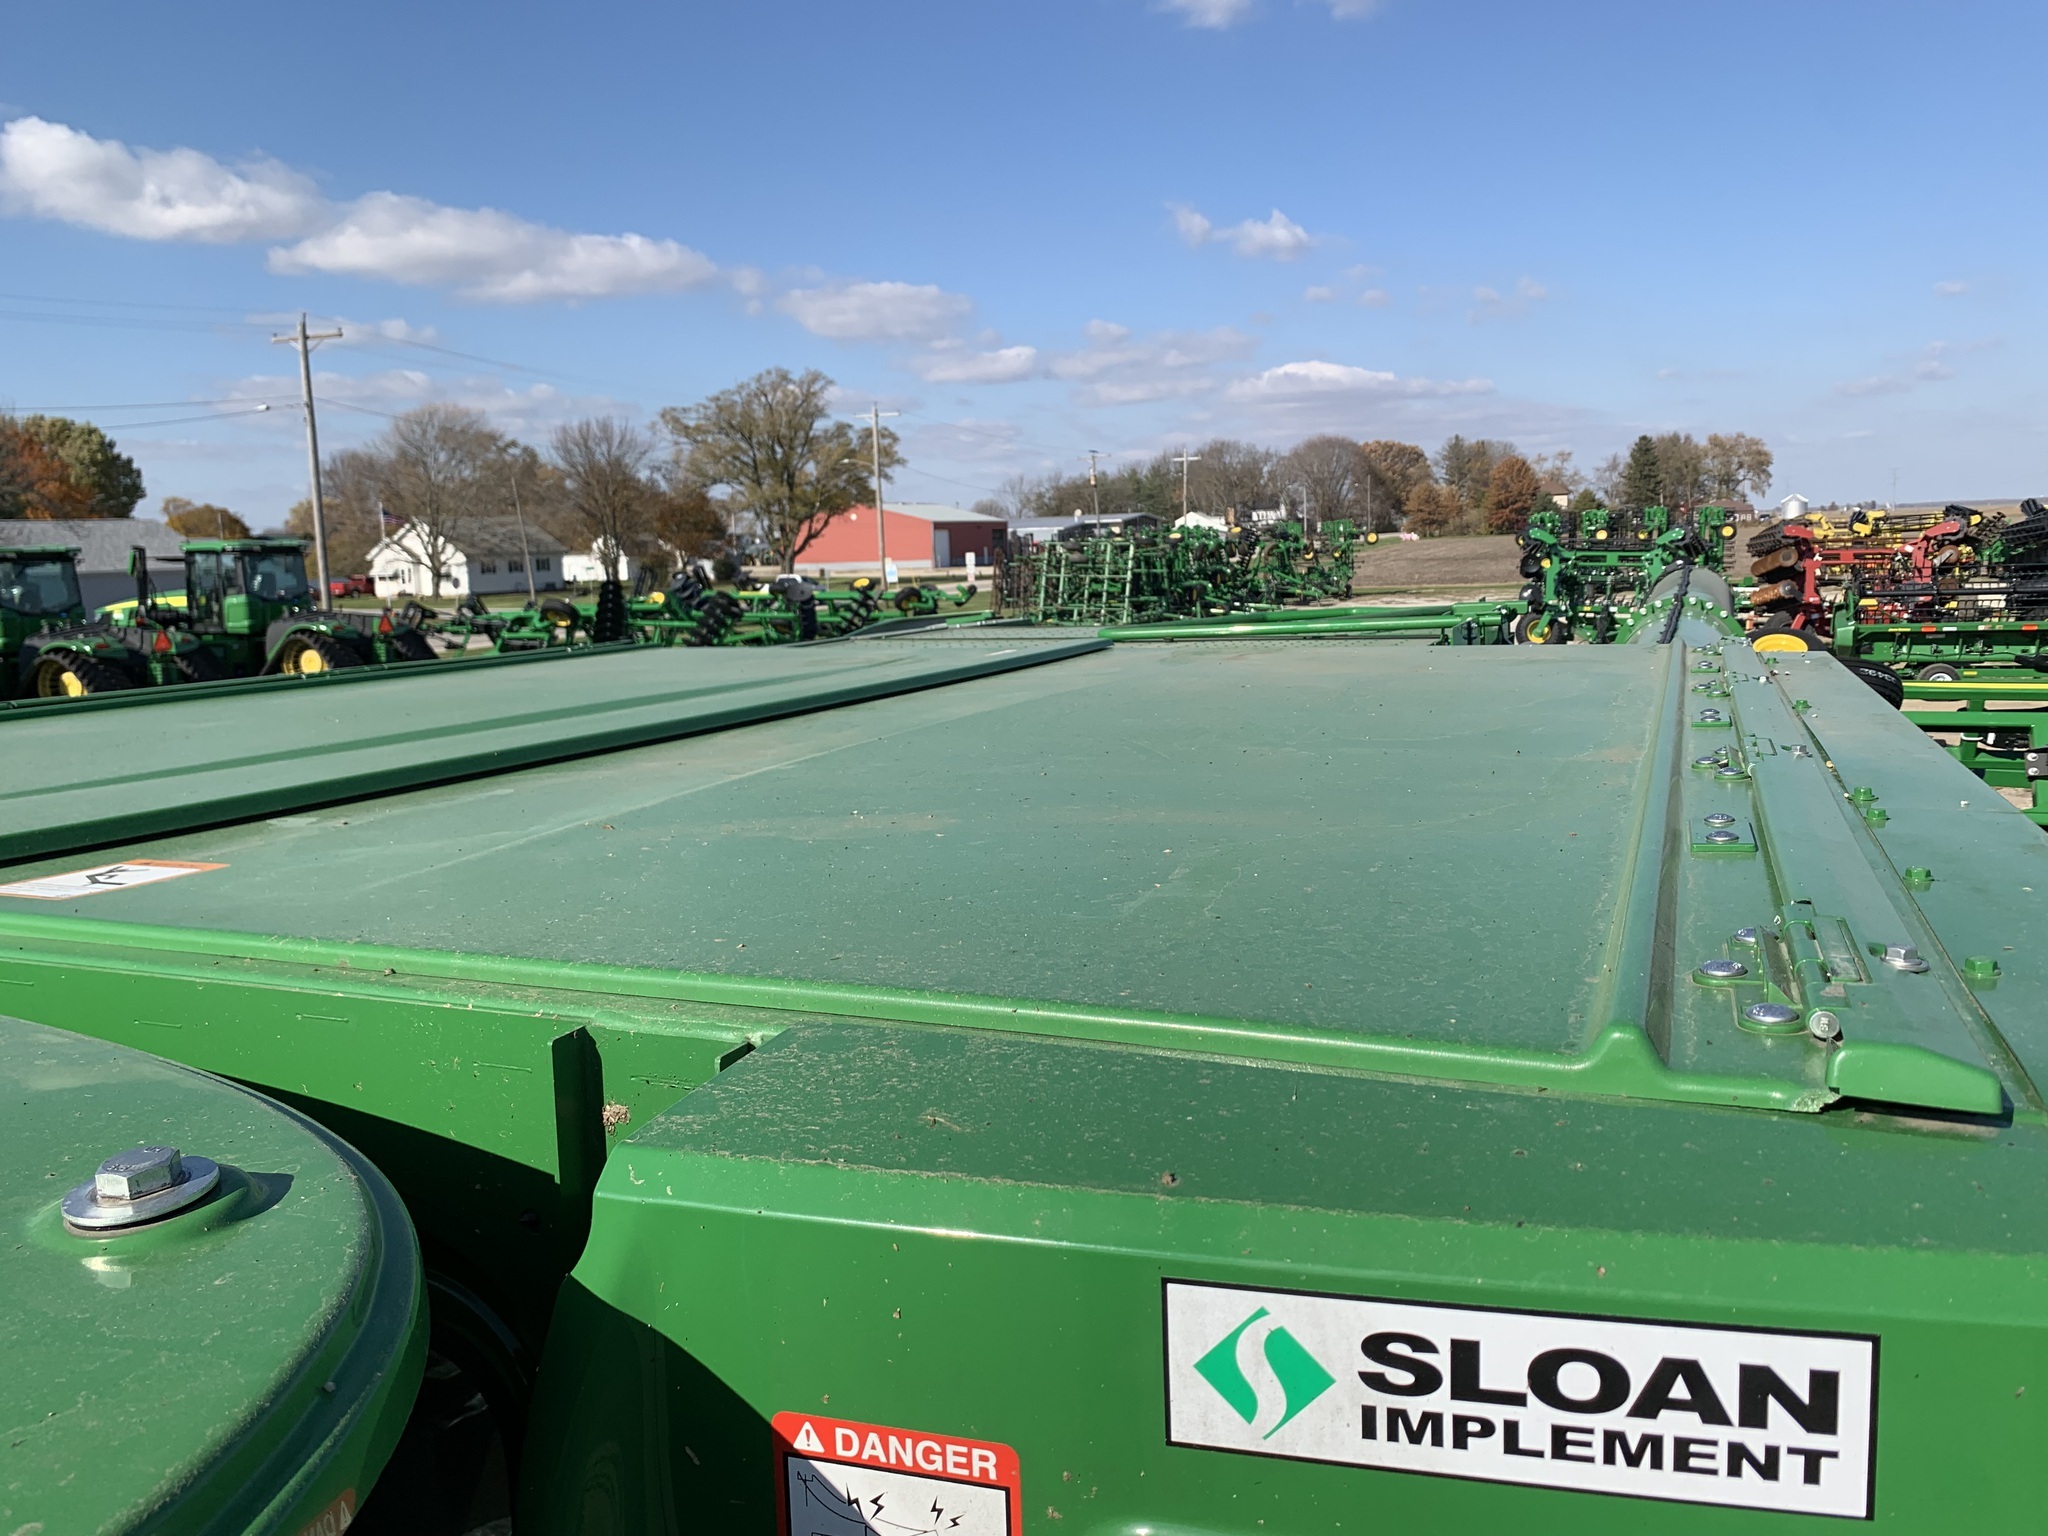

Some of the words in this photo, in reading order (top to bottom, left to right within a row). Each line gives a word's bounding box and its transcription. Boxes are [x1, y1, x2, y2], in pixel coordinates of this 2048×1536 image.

[1357, 1332, 1839, 1437] SLOAN
[834, 1427, 998, 1481] DANGER
[1361, 1404, 1840, 1486] IMPLEMENT
